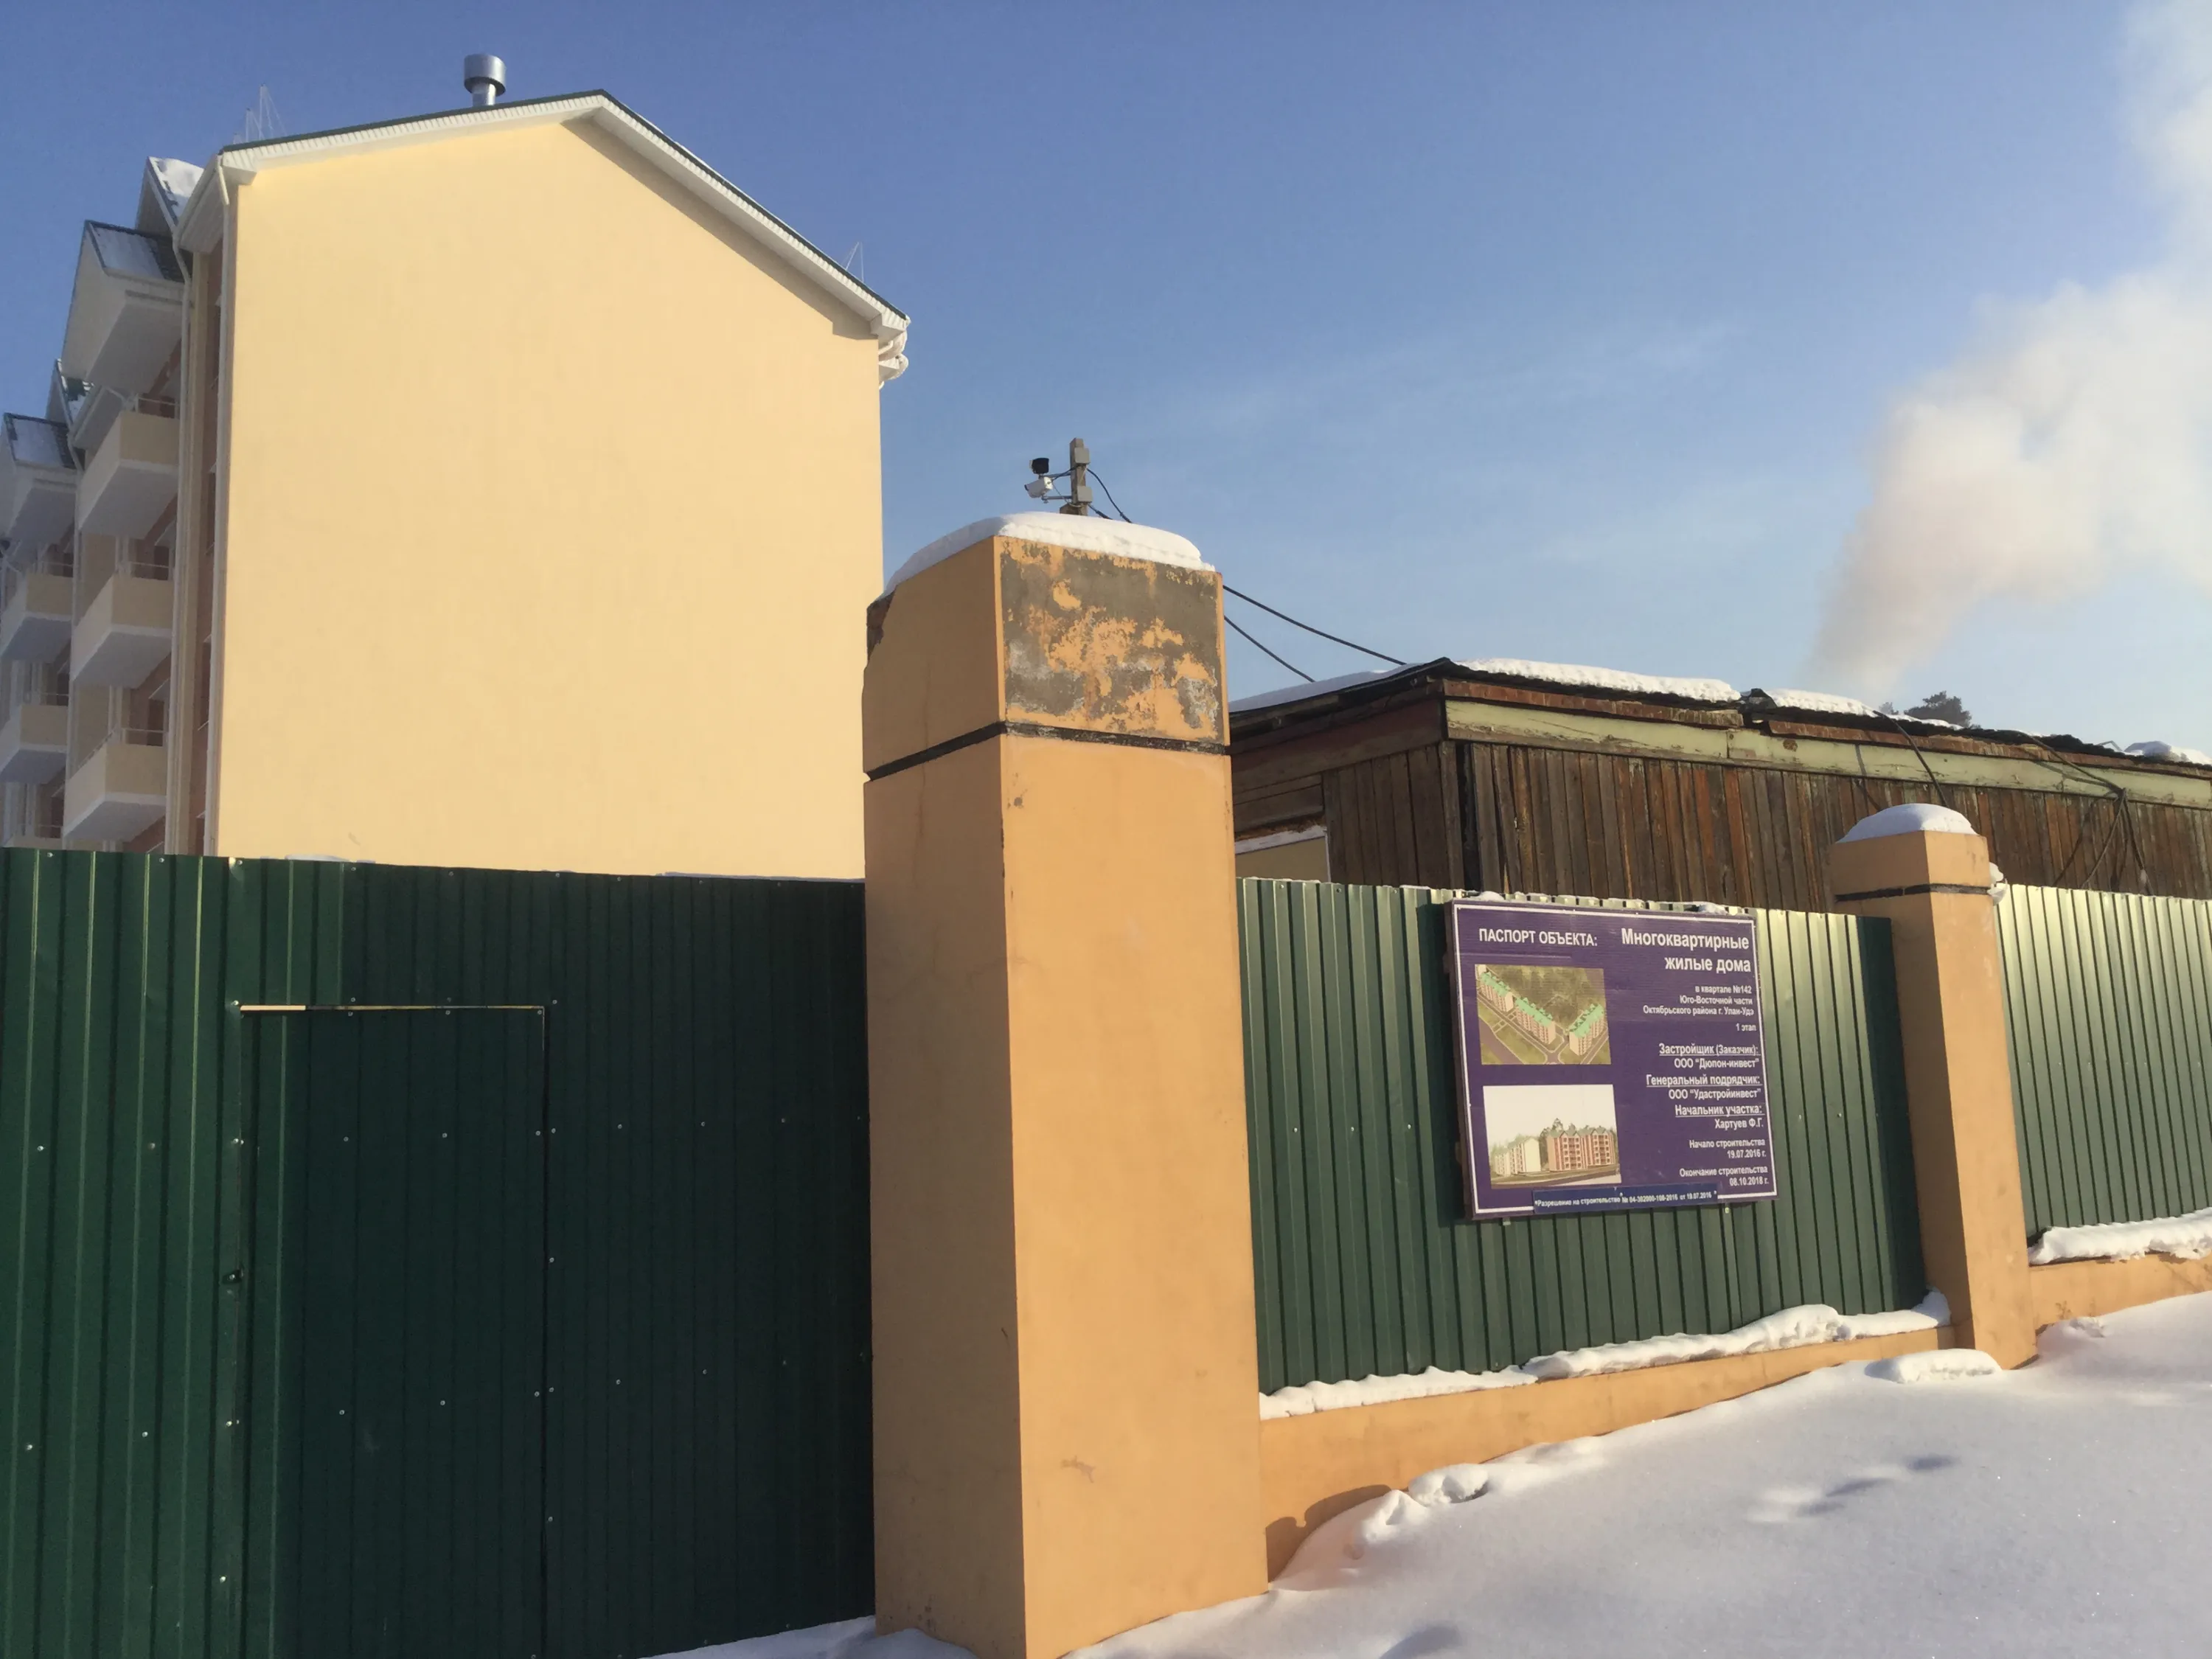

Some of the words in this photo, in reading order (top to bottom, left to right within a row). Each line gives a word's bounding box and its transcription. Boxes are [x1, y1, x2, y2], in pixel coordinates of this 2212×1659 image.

[1479, 928, 1536, 944] ПАСПОРТ
[1539, 931, 1598, 947] ОБЪЕКТА:
[1621, 928, 1750, 952] Многоквартирные
[1664, 957, 1713, 971] жилые
[1716, 959, 1751, 974] дома
[1701, 987, 1731, 995] квартале
[1733, 986, 1752, 994] №142
[1680, 995, 1732, 1005] Юго-Восточной
[1643, 1005, 1691, 1015] Октябрьского
[1692, 1006, 1717, 1017] района
[1724, 1006, 1754, 1016] Улан-Удэ
[1736, 1023, 1740, 1032] 1
[1659, 1043, 1714, 1057] Застройщик
[1716, 1044, 1759, 1057] (Заказчик):
[1674, 1058, 1694, 1068] ООО
[1646, 1074, 1708, 1088] Генеральный
[1710, 1075, 1761, 1087] подрядчик:
[1669, 1089, 1688, 1099] ООО
[1675, 1105, 1725, 1116] Начальник
[1725, 1105, 1762, 1117] участка:
[1714, 1119, 1747, 1130] Хартуев
[1748, 1118, 1764, 1127] Ф.Г.
[1689, 1140, 1715, 1149] Начало
[1716, 1139, 1765, 1149] строительства
[1727, 1150, 1761, 1159] 19.07.2016
[1680, 1168, 1717, 1178] Окончание
[1718, 1166, 1768, 1177] строительства
[1729, 1177, 1764, 1186] 08.10.2018
[1580, 1197, 1621, 1205] строительство
